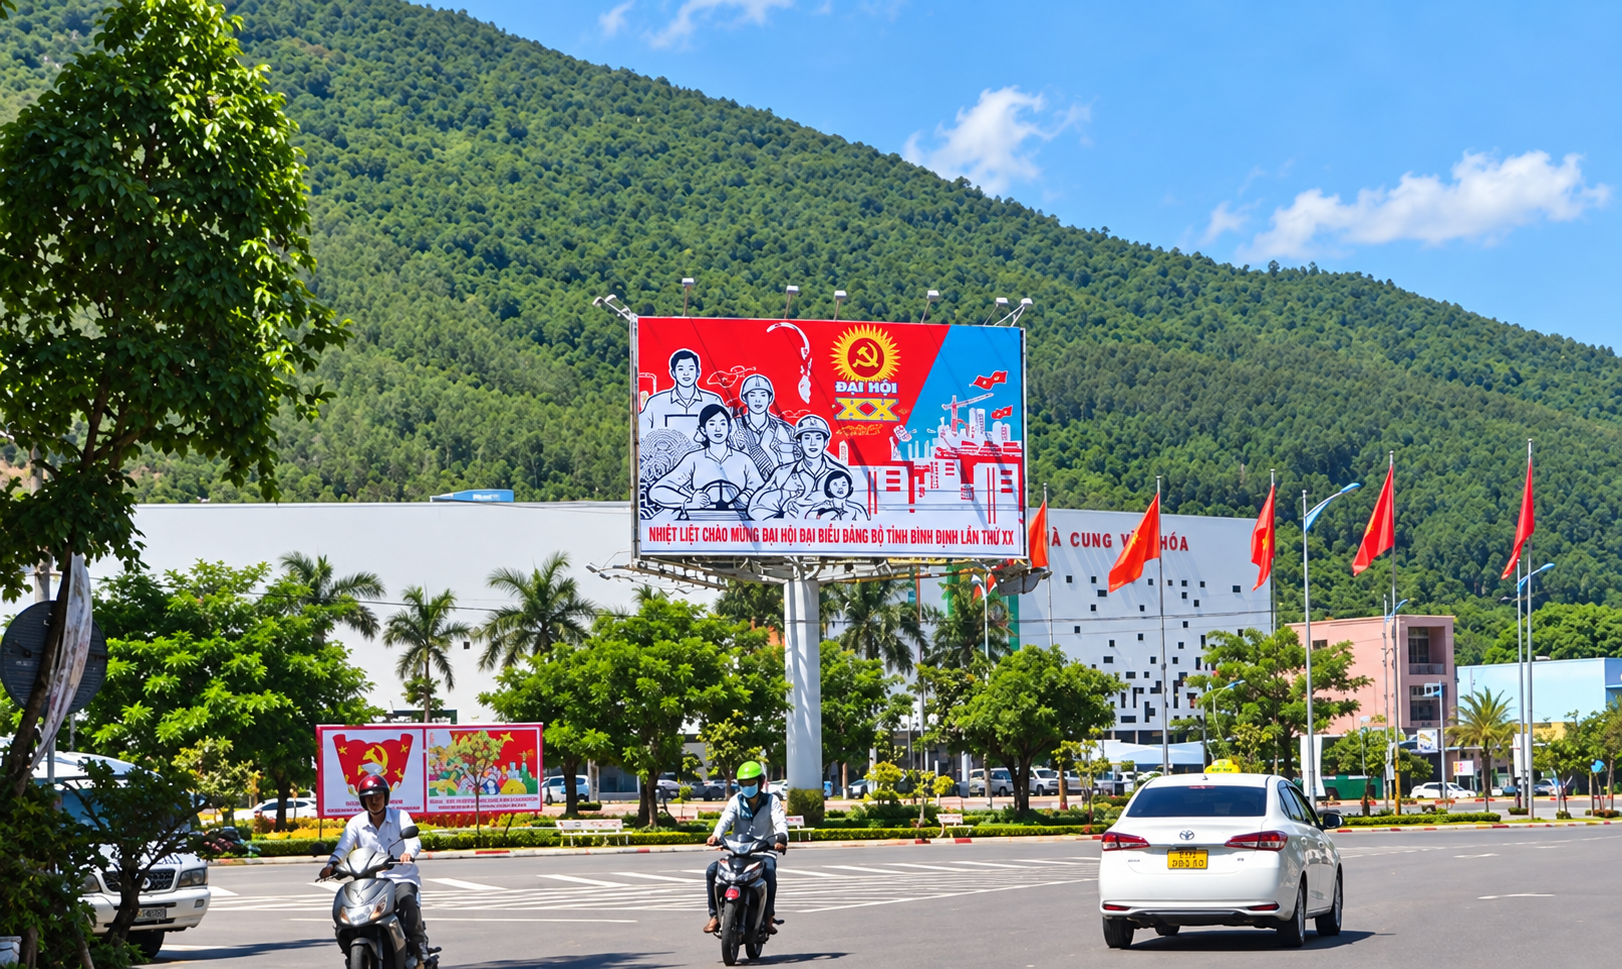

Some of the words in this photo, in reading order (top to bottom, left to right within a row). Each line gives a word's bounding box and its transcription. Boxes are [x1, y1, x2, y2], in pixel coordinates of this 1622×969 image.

[835, 381, 864, 396] ĐẠI
[868, 379, 898, 397] HỘI
[834, 397, 900, 422] XX
[648, 523, 678, 545] NHIỆT
[679, 523, 700, 546] LIỆT
[702, 523, 728, 542] CHÀO
[762, 527, 779, 546] ĐẠI
[780, 524, 797, 546] HỘI
[799, 527, 816, 546] ĐẠI
[910, 526, 934, 544] BÌNH
[936, 529, 958, 548] ĐỊNH
[981, 526, 1001, 546] THỨ
[1001, 530, 1014, 546] XX
[1070, 531, 1112, 548] CUNG
[1160, 531, 1189, 551] HÓA
